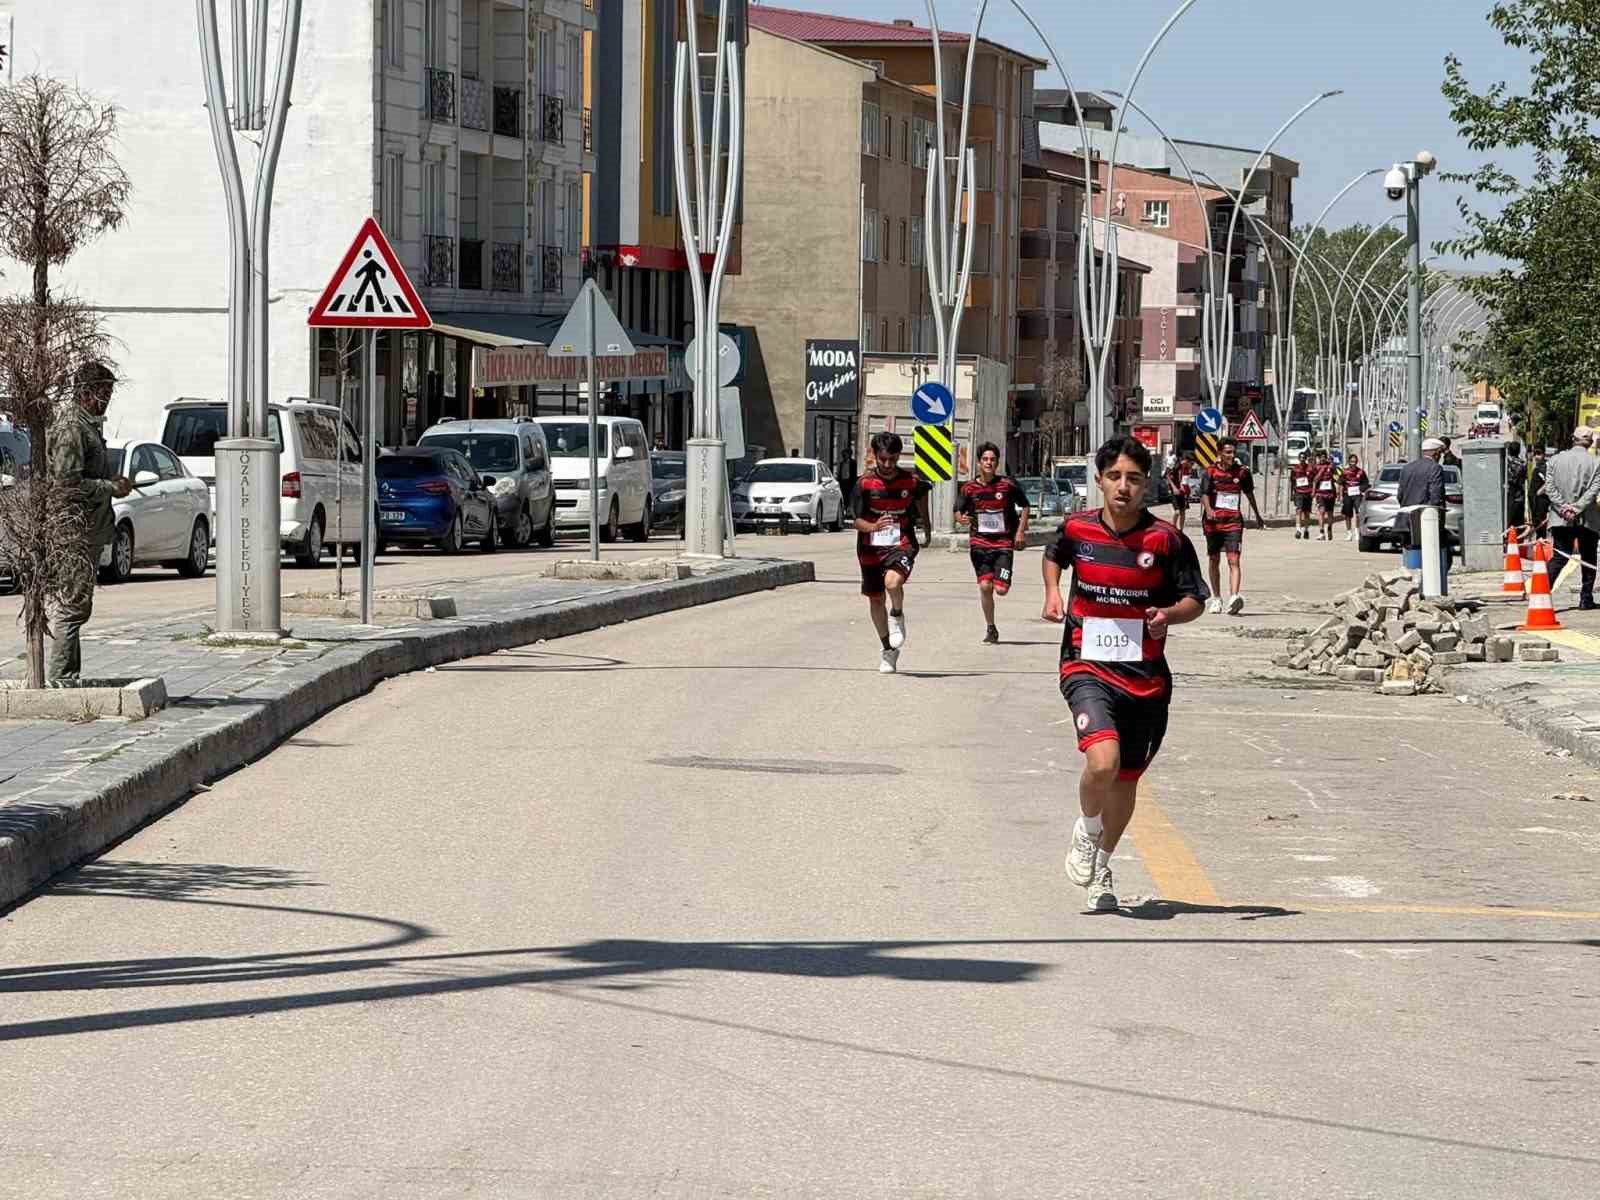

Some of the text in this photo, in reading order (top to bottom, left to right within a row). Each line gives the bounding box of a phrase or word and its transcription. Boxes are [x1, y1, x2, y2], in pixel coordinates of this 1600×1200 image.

[809, 350, 856, 367] MODA
[806, 370, 857, 404] Giyim
[240, 450, 250, 508] ÖZALP
[1000, 567, 1010, 580] 16
[1096, 634, 1129, 648] 1019
